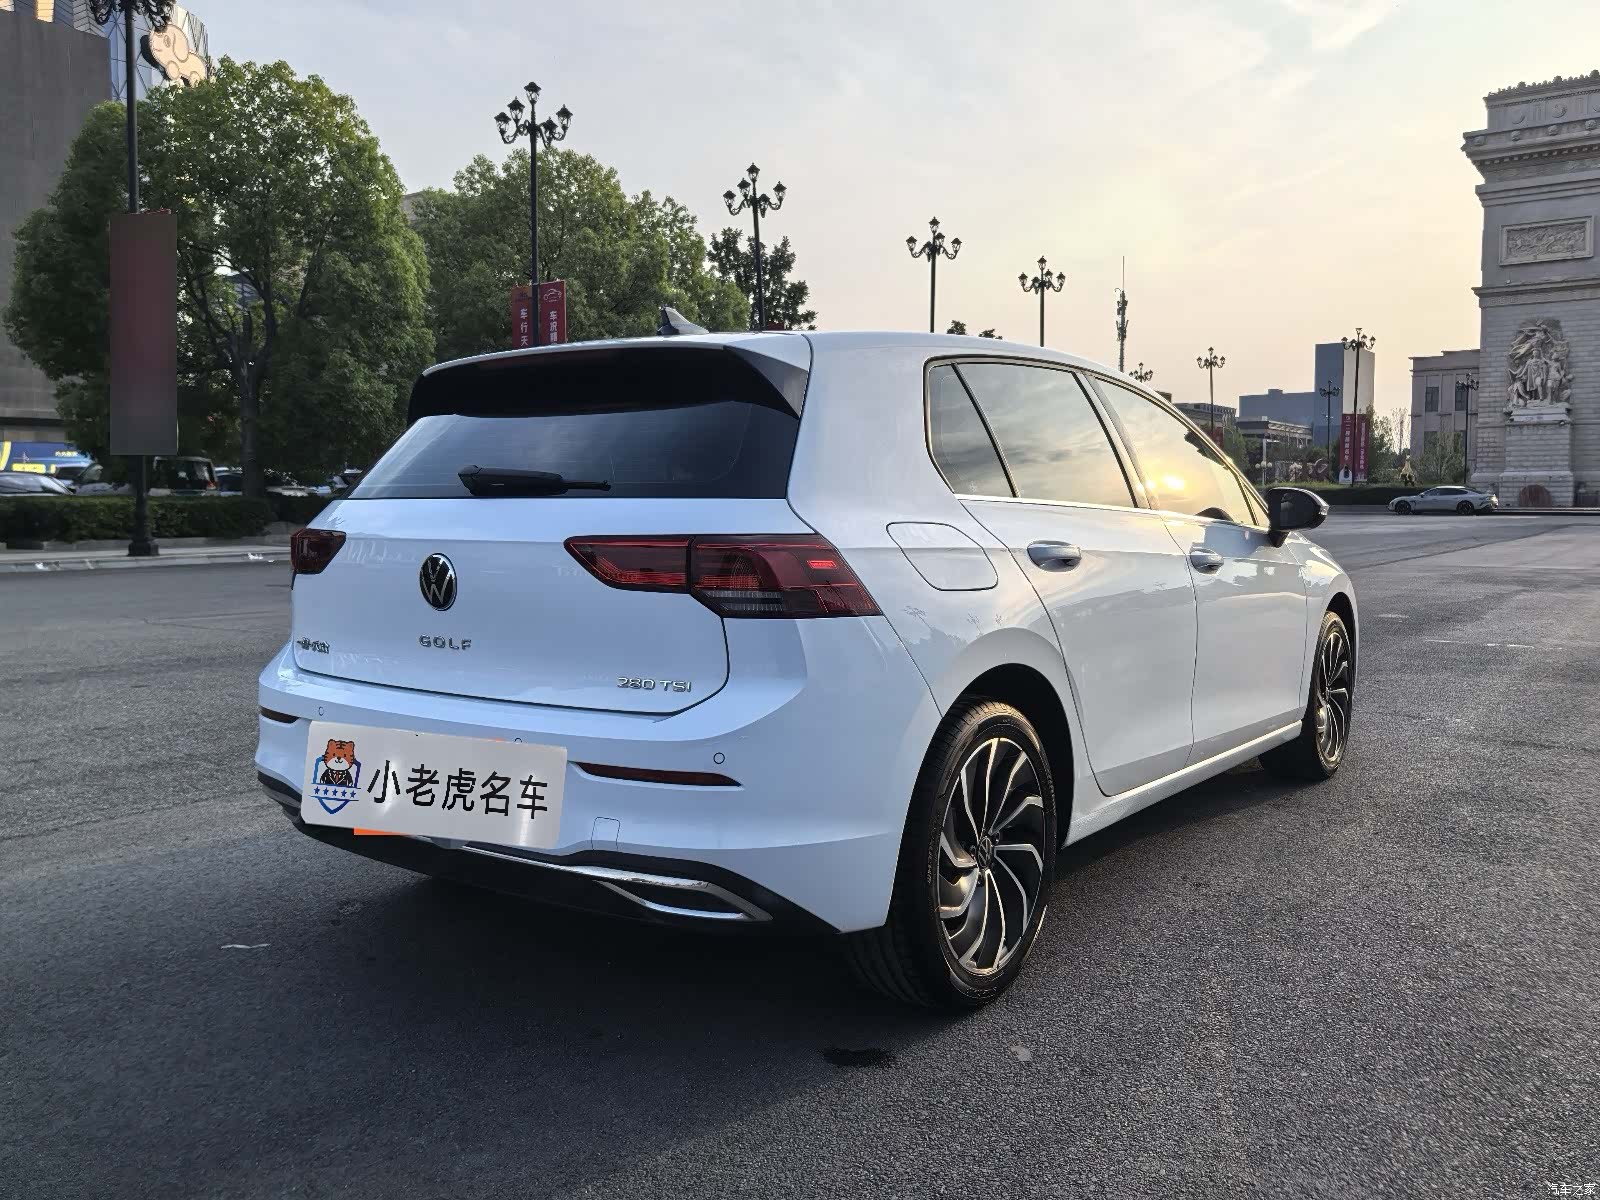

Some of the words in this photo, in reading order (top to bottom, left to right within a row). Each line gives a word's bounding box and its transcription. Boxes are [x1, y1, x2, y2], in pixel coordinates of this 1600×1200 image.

[419, 634, 472, 650] GOLF
[617, 676, 656, 691] 280
[659, 680, 692, 693] TSI
[367, 759, 548, 820] 小老虎名车
